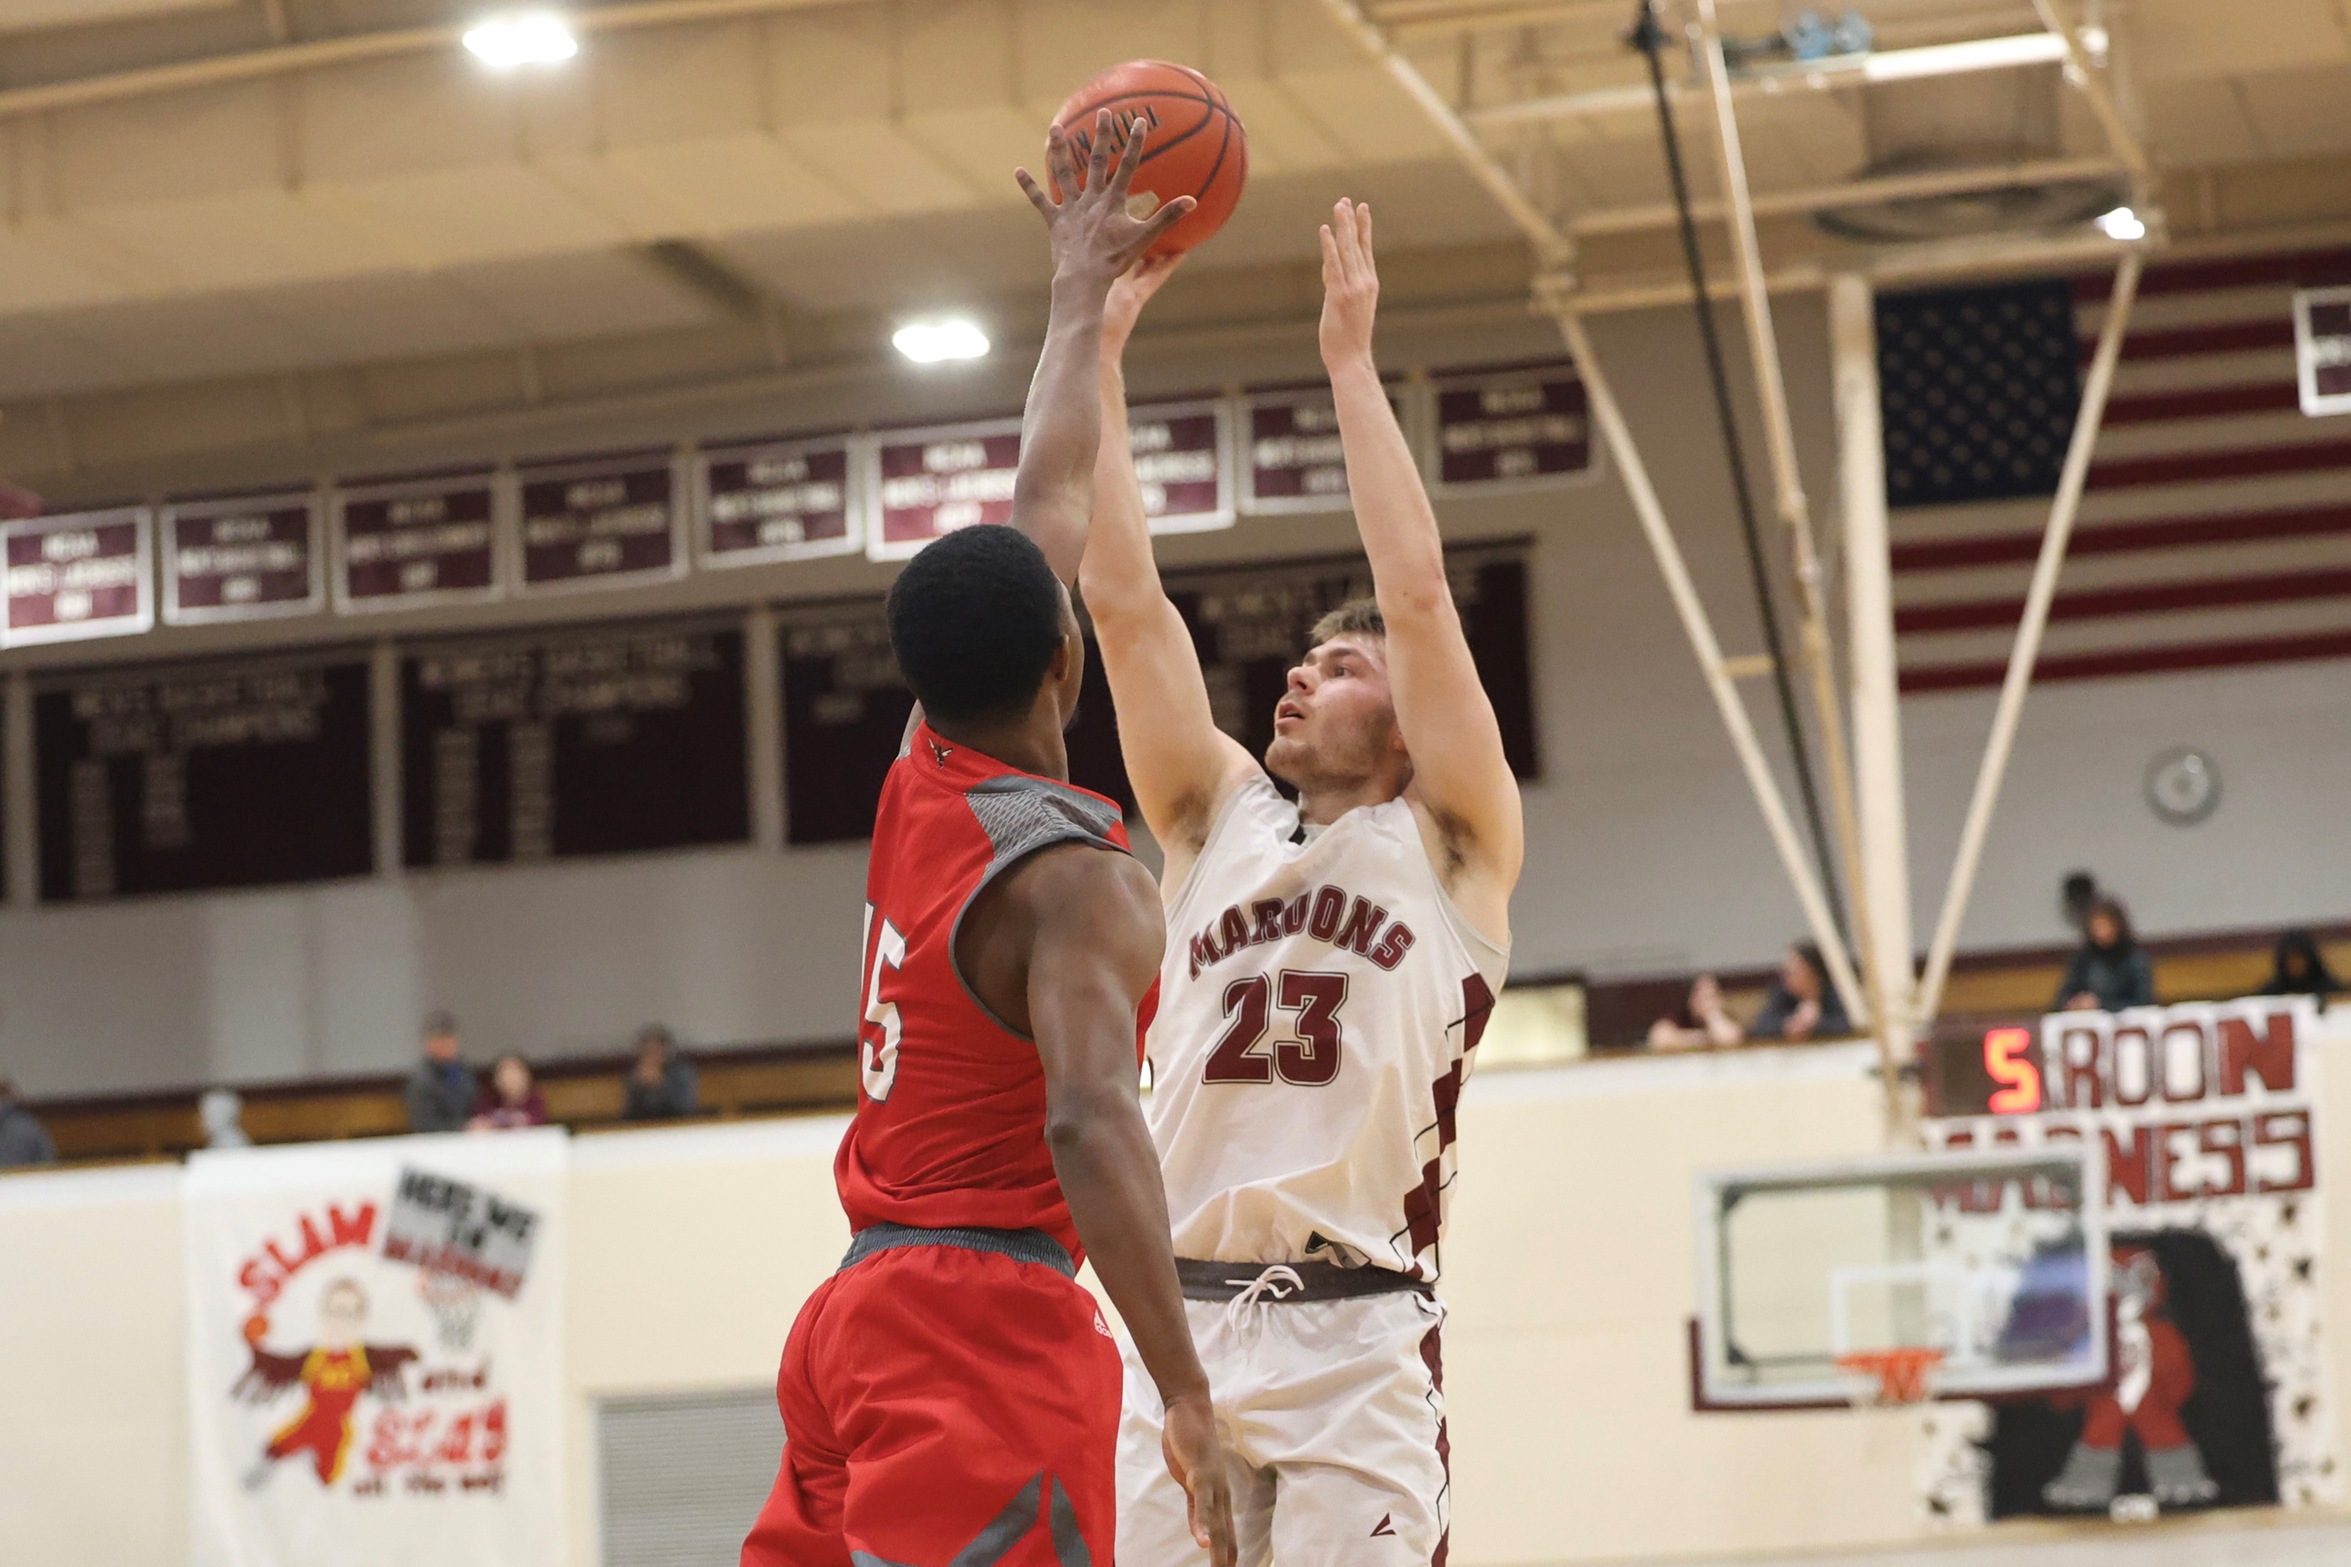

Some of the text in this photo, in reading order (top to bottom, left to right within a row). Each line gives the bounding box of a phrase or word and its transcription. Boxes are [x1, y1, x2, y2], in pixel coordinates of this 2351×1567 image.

[1189, 885, 1416, 982] MAROONS
[1202, 969, 1349, 1086] 23
[1984, 1027, 2041, 1114] 5
[2058, 1013, 2296, 1112] ROON
